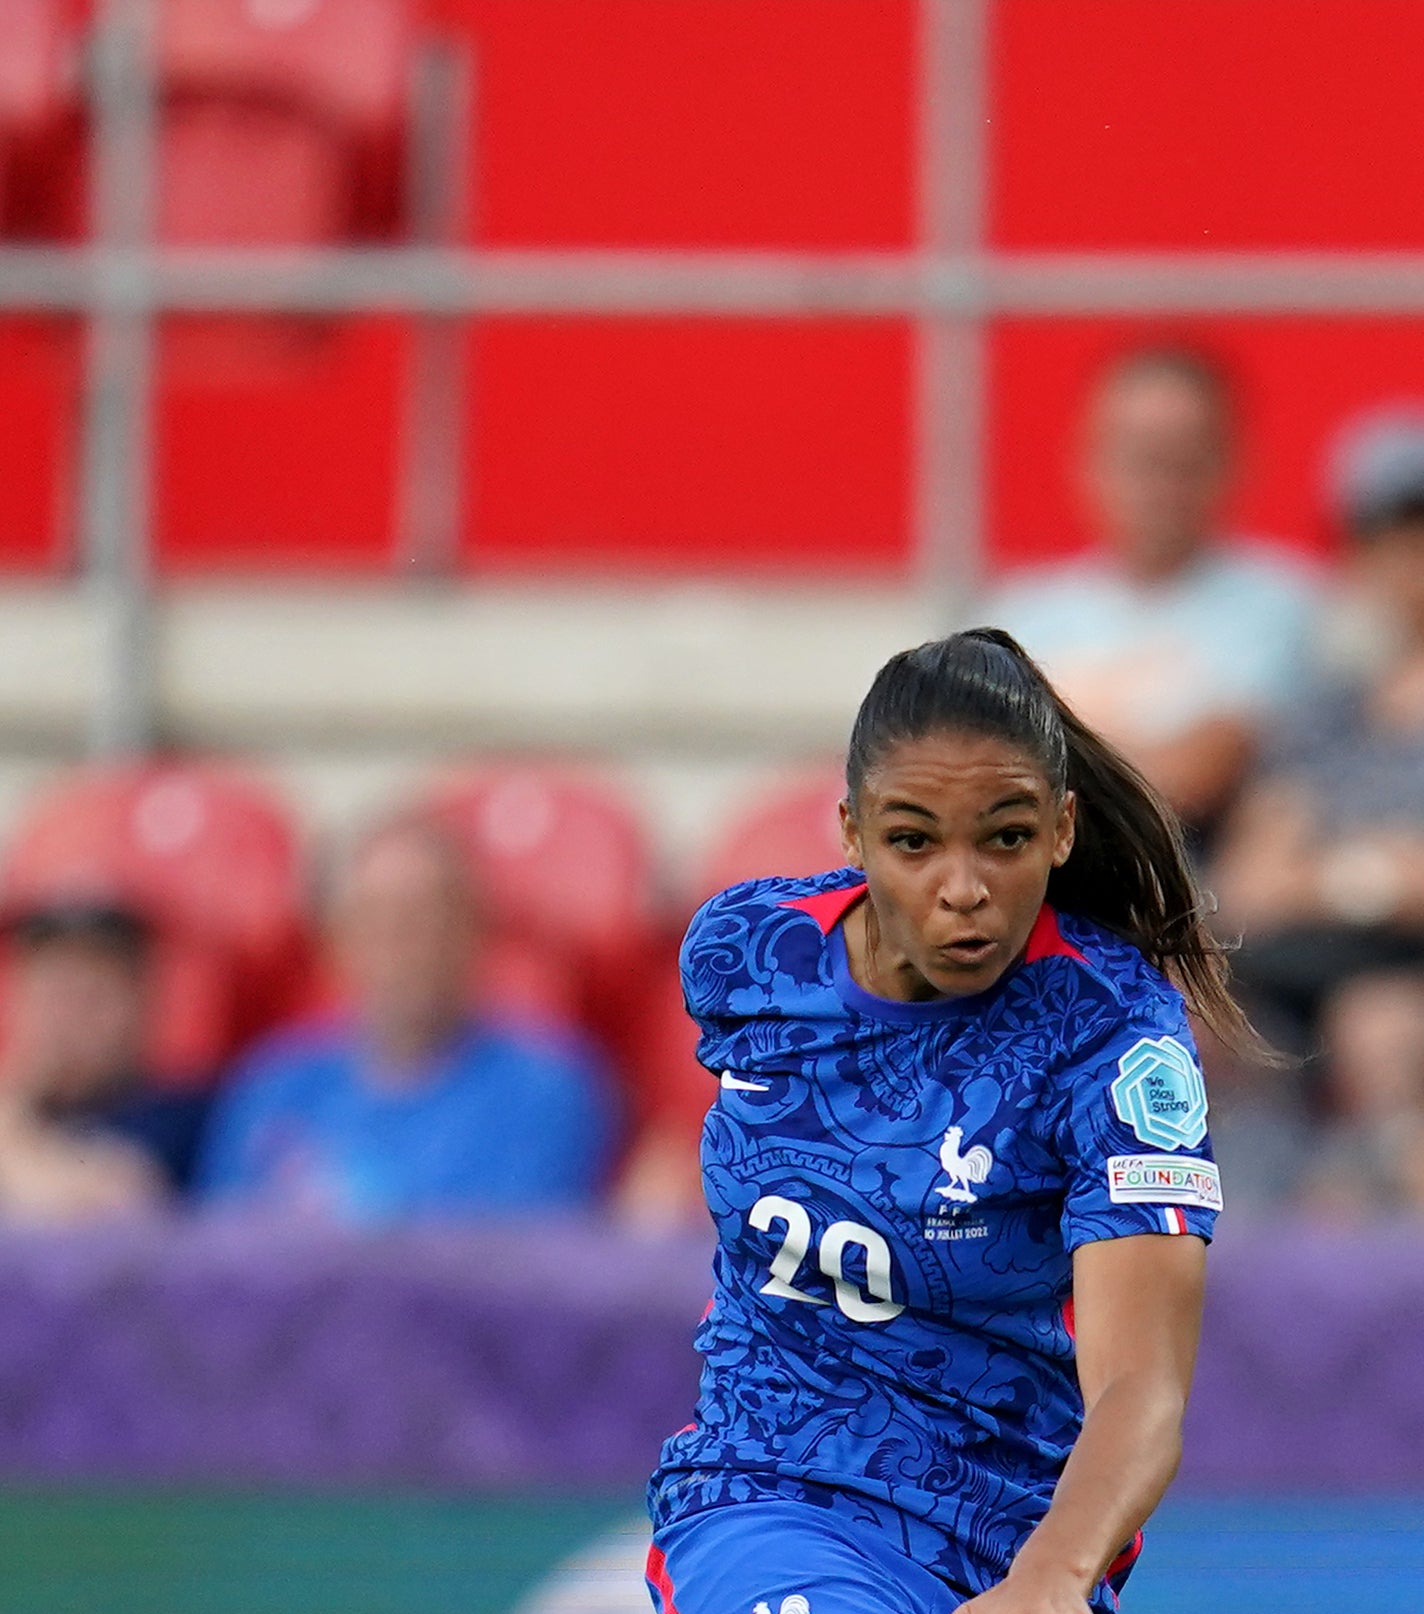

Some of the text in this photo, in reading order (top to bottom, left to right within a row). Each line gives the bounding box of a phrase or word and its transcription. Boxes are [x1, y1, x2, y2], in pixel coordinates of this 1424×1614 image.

[1146, 1076, 1165, 1088] We
[1152, 1100, 1190, 1113] Strong
[1112, 1158, 1144, 1169] UEFA
[748, 1195, 906, 1323] 20
